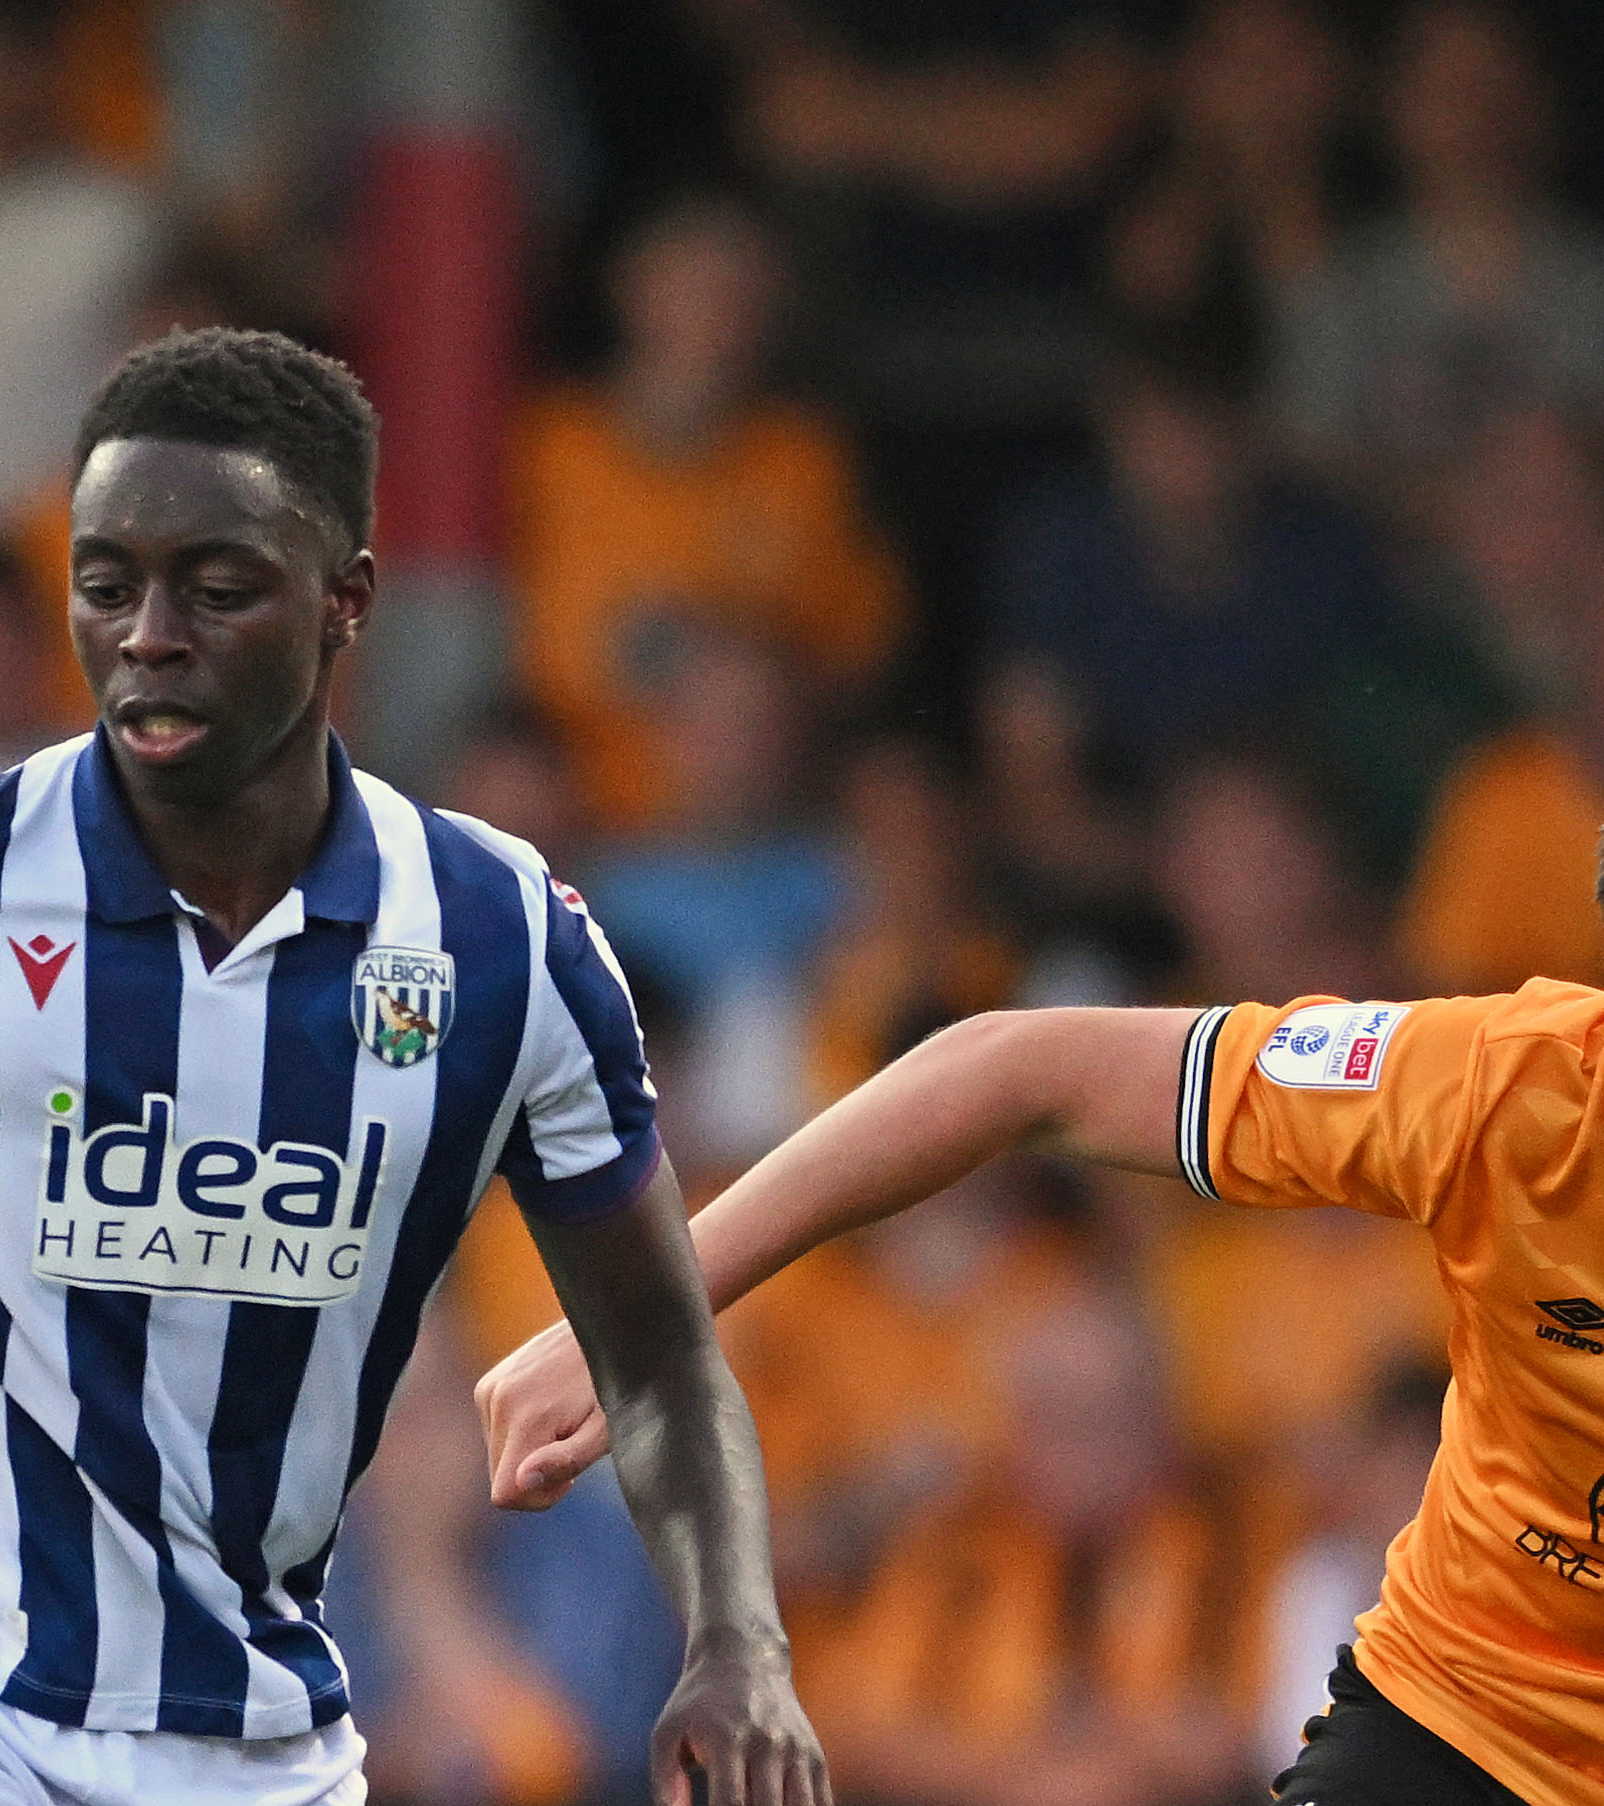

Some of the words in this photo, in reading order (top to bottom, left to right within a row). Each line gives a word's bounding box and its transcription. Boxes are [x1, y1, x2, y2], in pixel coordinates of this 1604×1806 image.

[360, 962, 447, 985] ALBION
[1362, 1011, 1389, 1035] sky
[1267, 1027, 1292, 1052] EFL
[1329, 1051, 1346, 1077] ONE
[1349, 1041, 1376, 1076] bet
[48, 1092, 387, 1230] ideal
[40, 1218, 363, 1280] HEATING
